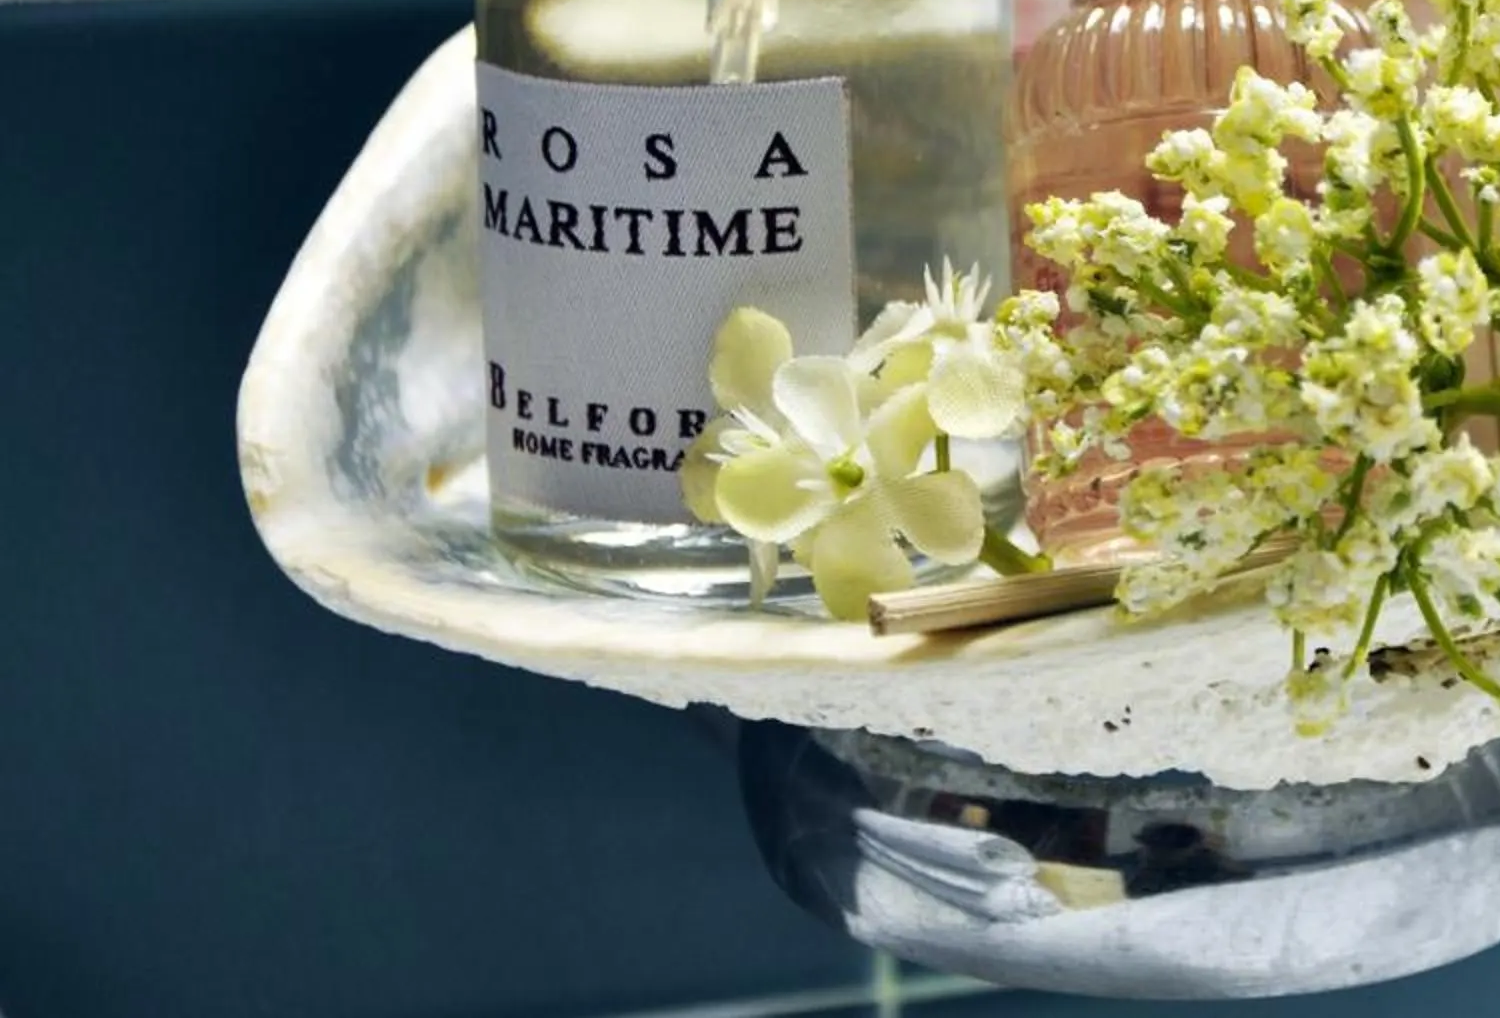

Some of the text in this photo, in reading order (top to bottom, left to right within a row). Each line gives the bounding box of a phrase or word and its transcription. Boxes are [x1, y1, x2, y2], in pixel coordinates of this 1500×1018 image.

[480, 107, 808, 181] ROSA
[482, 182, 803, 257] MARITIME
[512, 428, 573, 462] HOME
